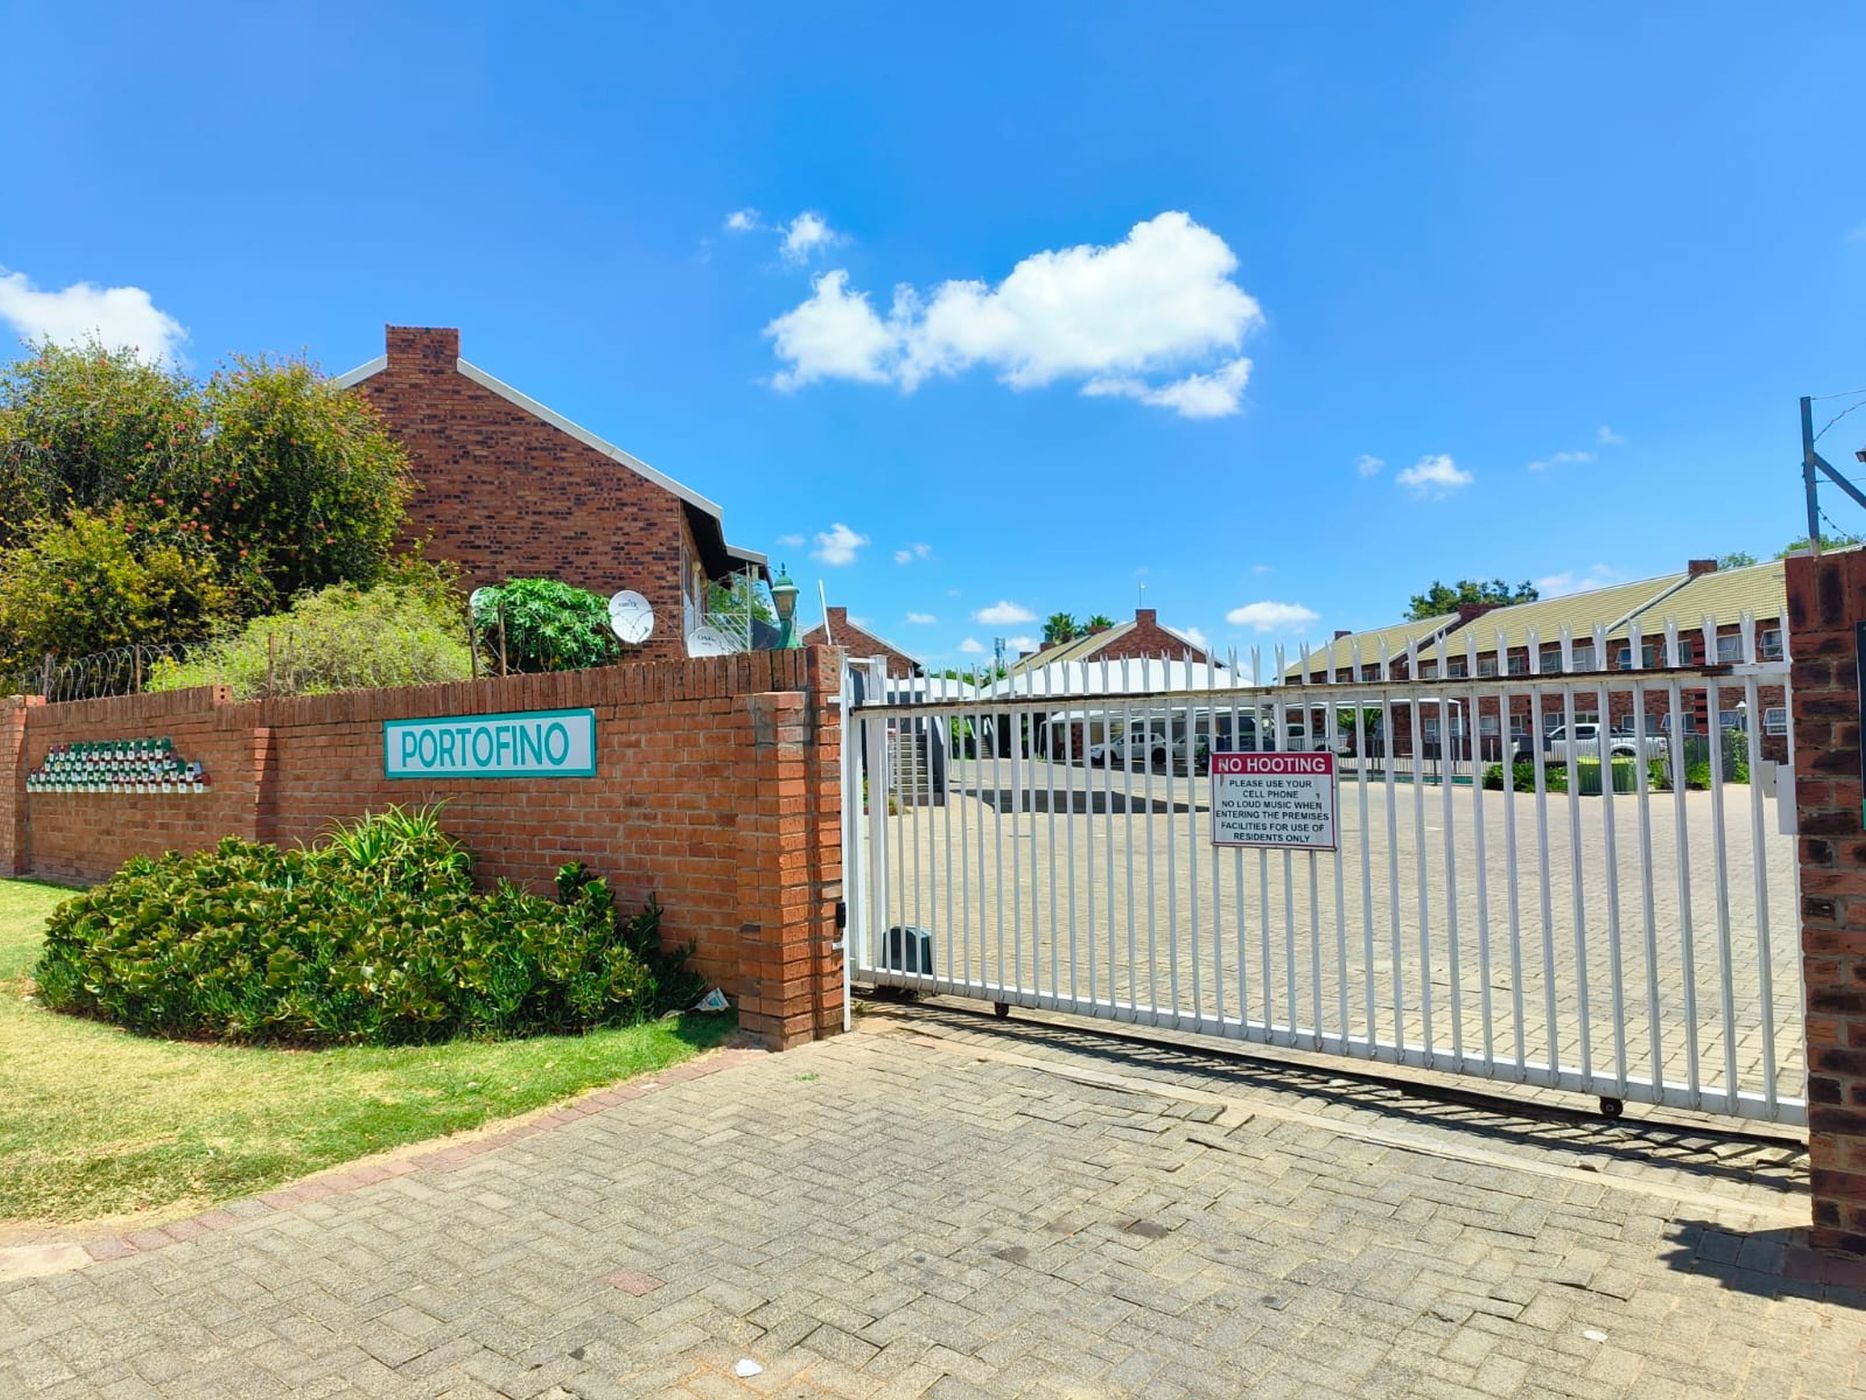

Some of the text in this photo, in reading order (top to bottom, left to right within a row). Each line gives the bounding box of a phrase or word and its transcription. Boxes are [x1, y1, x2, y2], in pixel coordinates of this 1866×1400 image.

[402, 722, 569, 768] PORTOFINO
[1218, 757, 1326, 772] NO HOOTING
[1229, 779, 1312, 789] PLEASE USE YOUR
[1242, 790, 1299, 799] CELL PHONE
[1221, 800, 1322, 810] NO LOUD MUSIC WHEN
[1216, 810, 1329, 821] ENTERING THE PREMISES
[1221, 821, 1325, 833] FACILITIES FOR USE OF
[1233, 832, 1311, 843] RESIDENTS ONLY
